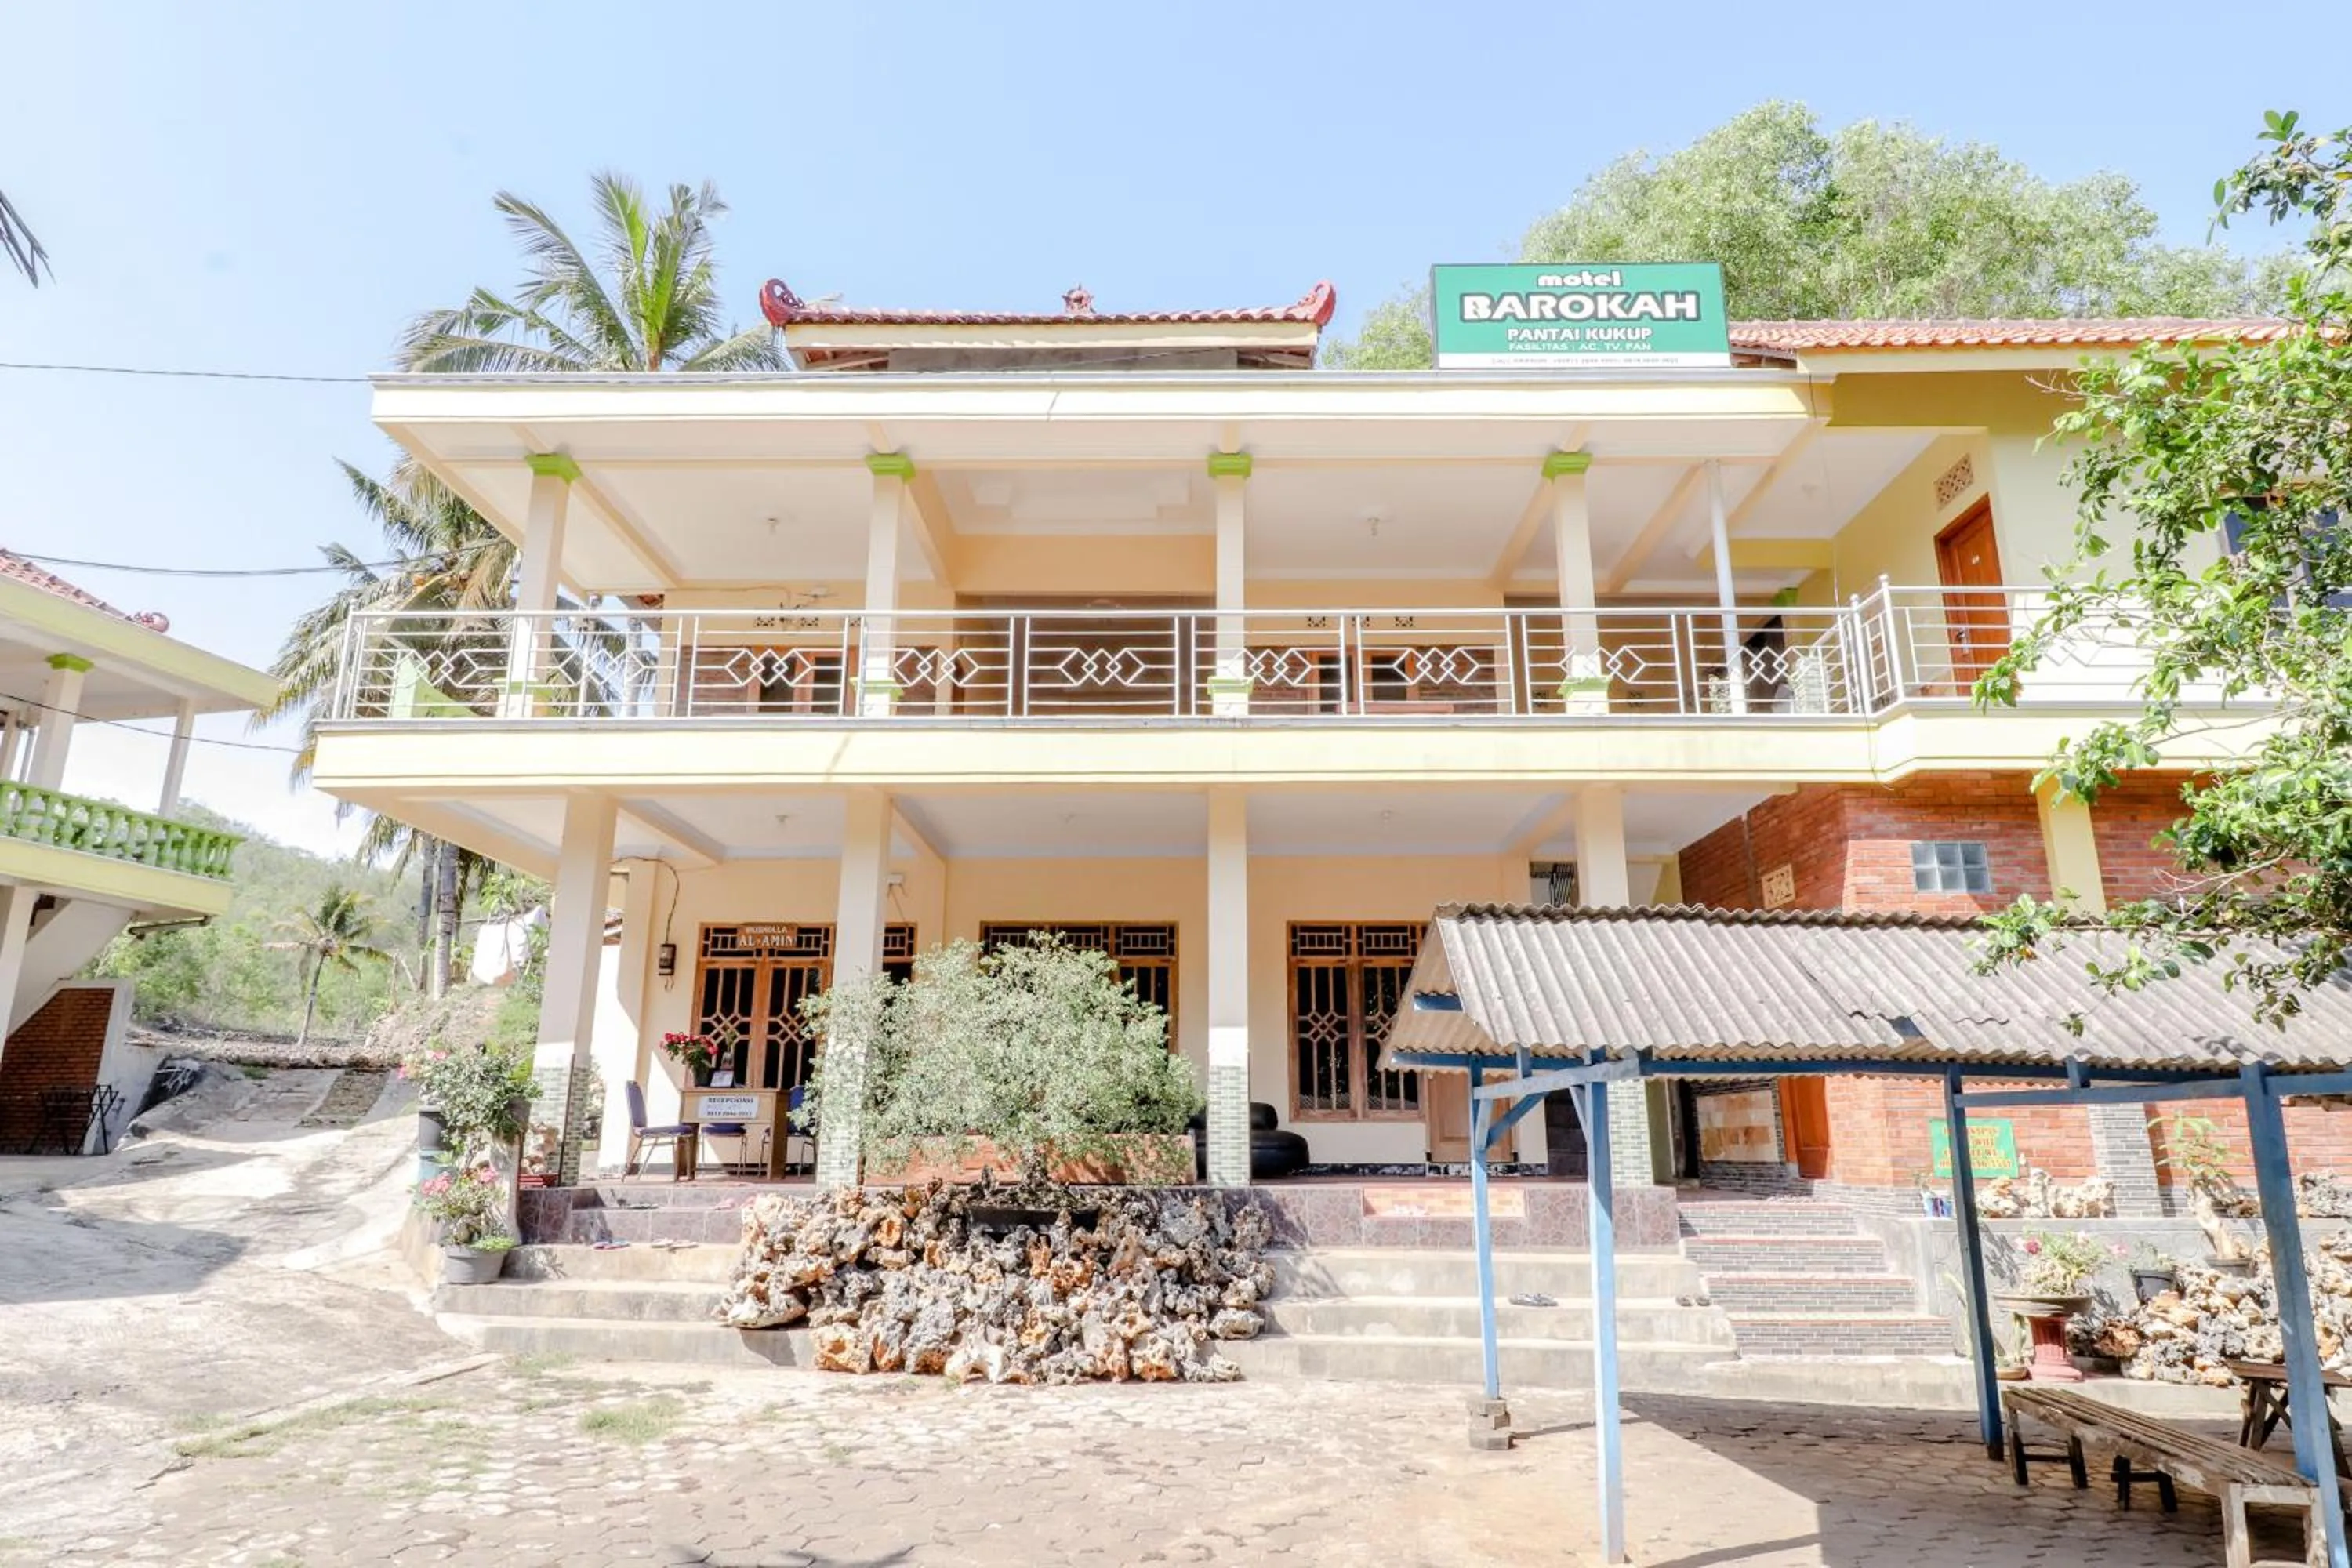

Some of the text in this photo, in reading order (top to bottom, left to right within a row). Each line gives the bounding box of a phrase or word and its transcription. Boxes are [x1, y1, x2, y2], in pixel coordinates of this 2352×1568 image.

[1537, 270, 1622, 287] motel
[1461, 292, 1700, 321] BAROKAH
[1507, 327, 1653, 341] PANTAI KUKUP
[1625, 341, 1652, 351] FAN
